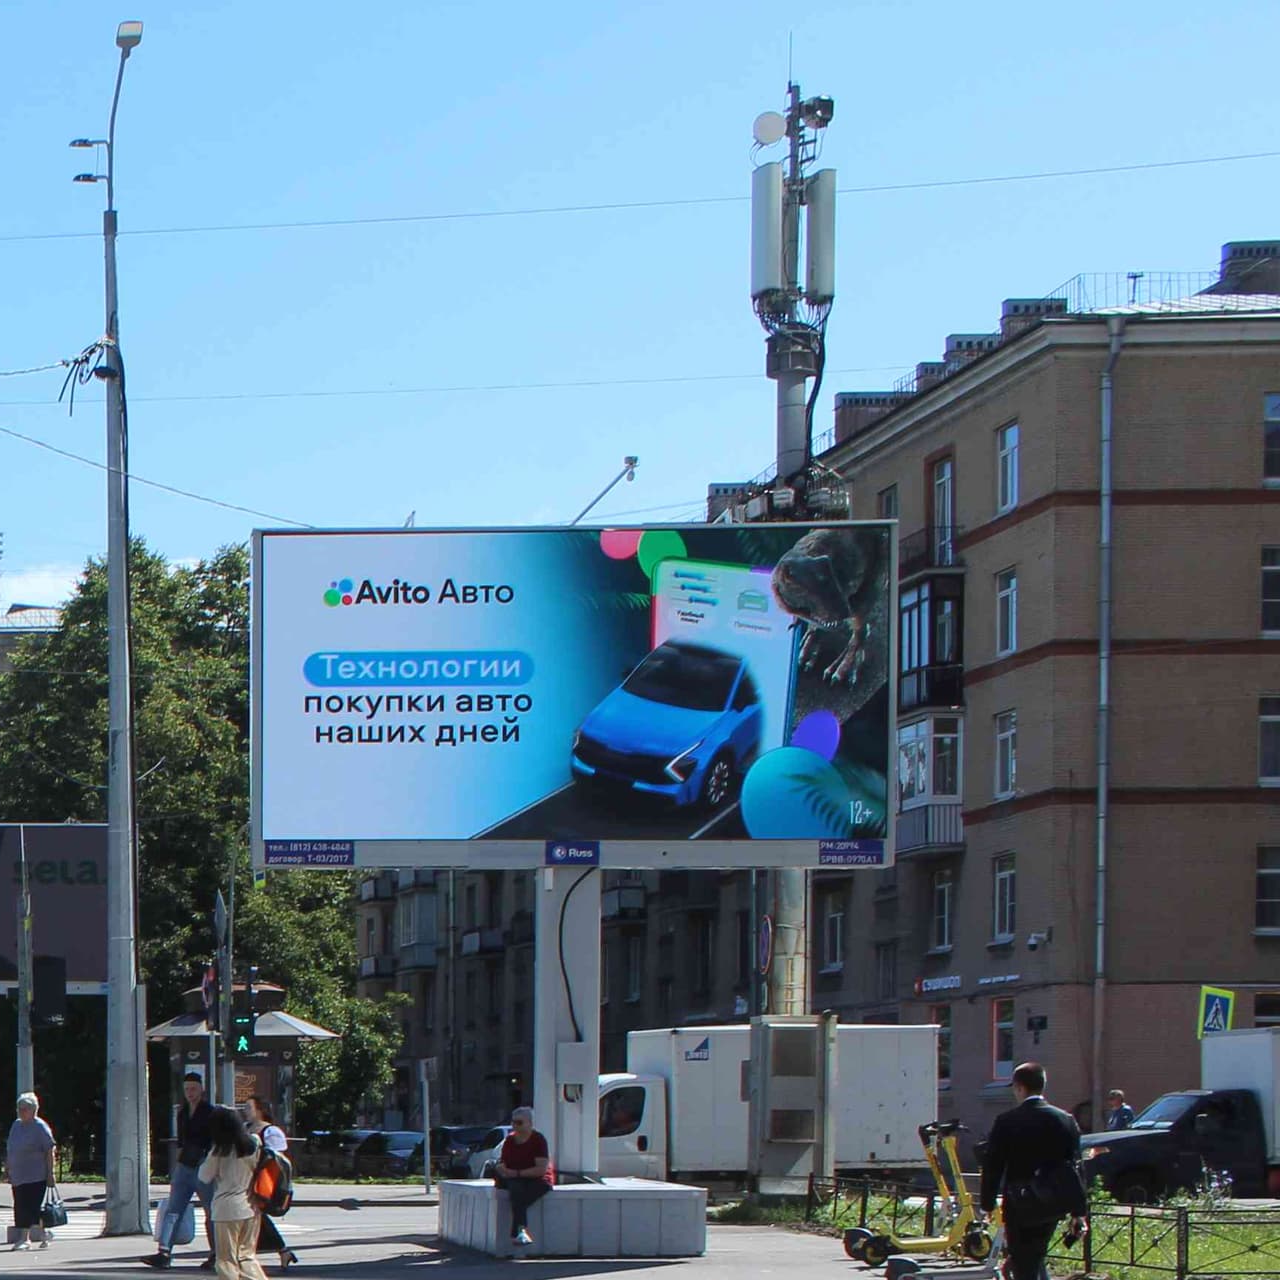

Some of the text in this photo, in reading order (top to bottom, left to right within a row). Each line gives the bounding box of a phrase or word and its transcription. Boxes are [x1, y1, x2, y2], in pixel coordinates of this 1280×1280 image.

[355, 578, 515, 605] Avito Авто
[318, 653, 522, 680] Технологии
[304, 693, 533, 720] покупки авто
[315, 716, 521, 747] наших дней
[848, 800, 873, 825] 12+
[568, 848, 593, 858] Russ
